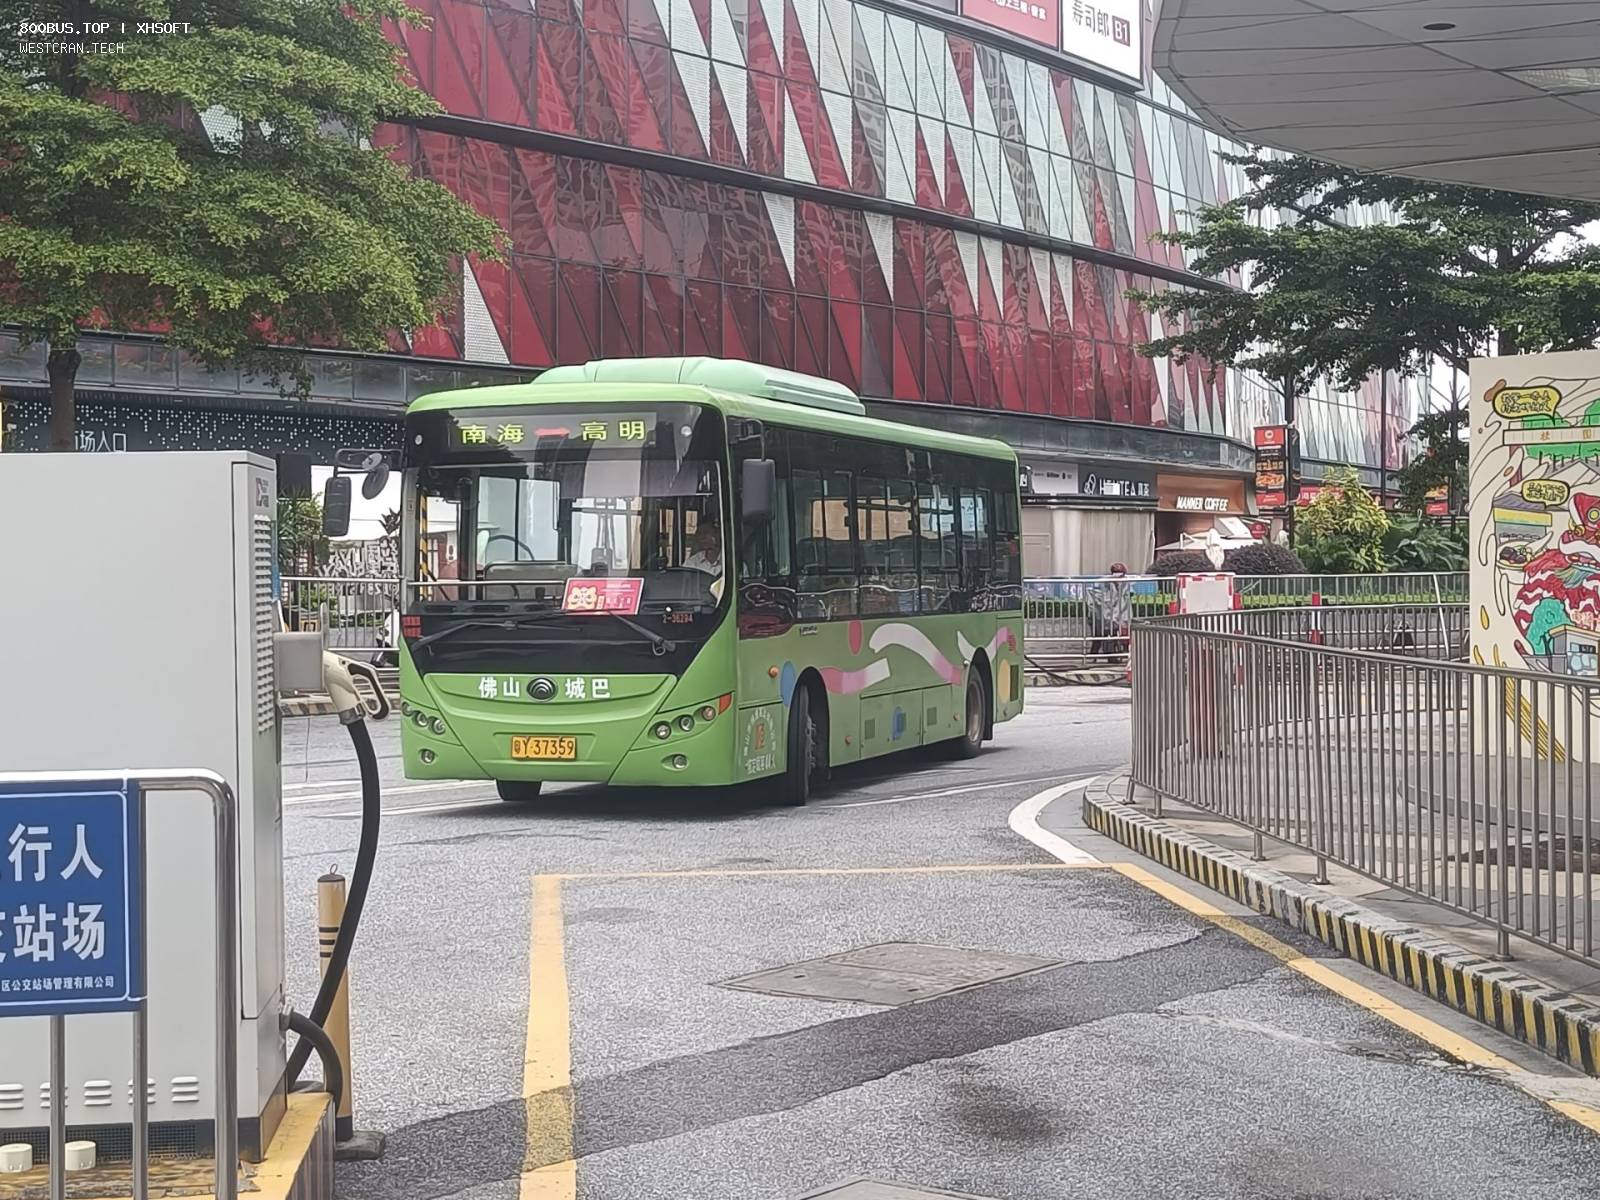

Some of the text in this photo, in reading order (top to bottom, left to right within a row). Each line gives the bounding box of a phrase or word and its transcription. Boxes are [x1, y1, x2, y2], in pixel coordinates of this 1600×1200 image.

[1114, 20, 1129, 42] B1
[74, 429, 127, 452] 场入口
[460, 420, 646, 444] 南海 高明
[1204, 497, 1229, 511] COFFEE
[479, 676, 611, 699] 佛山 城巴
